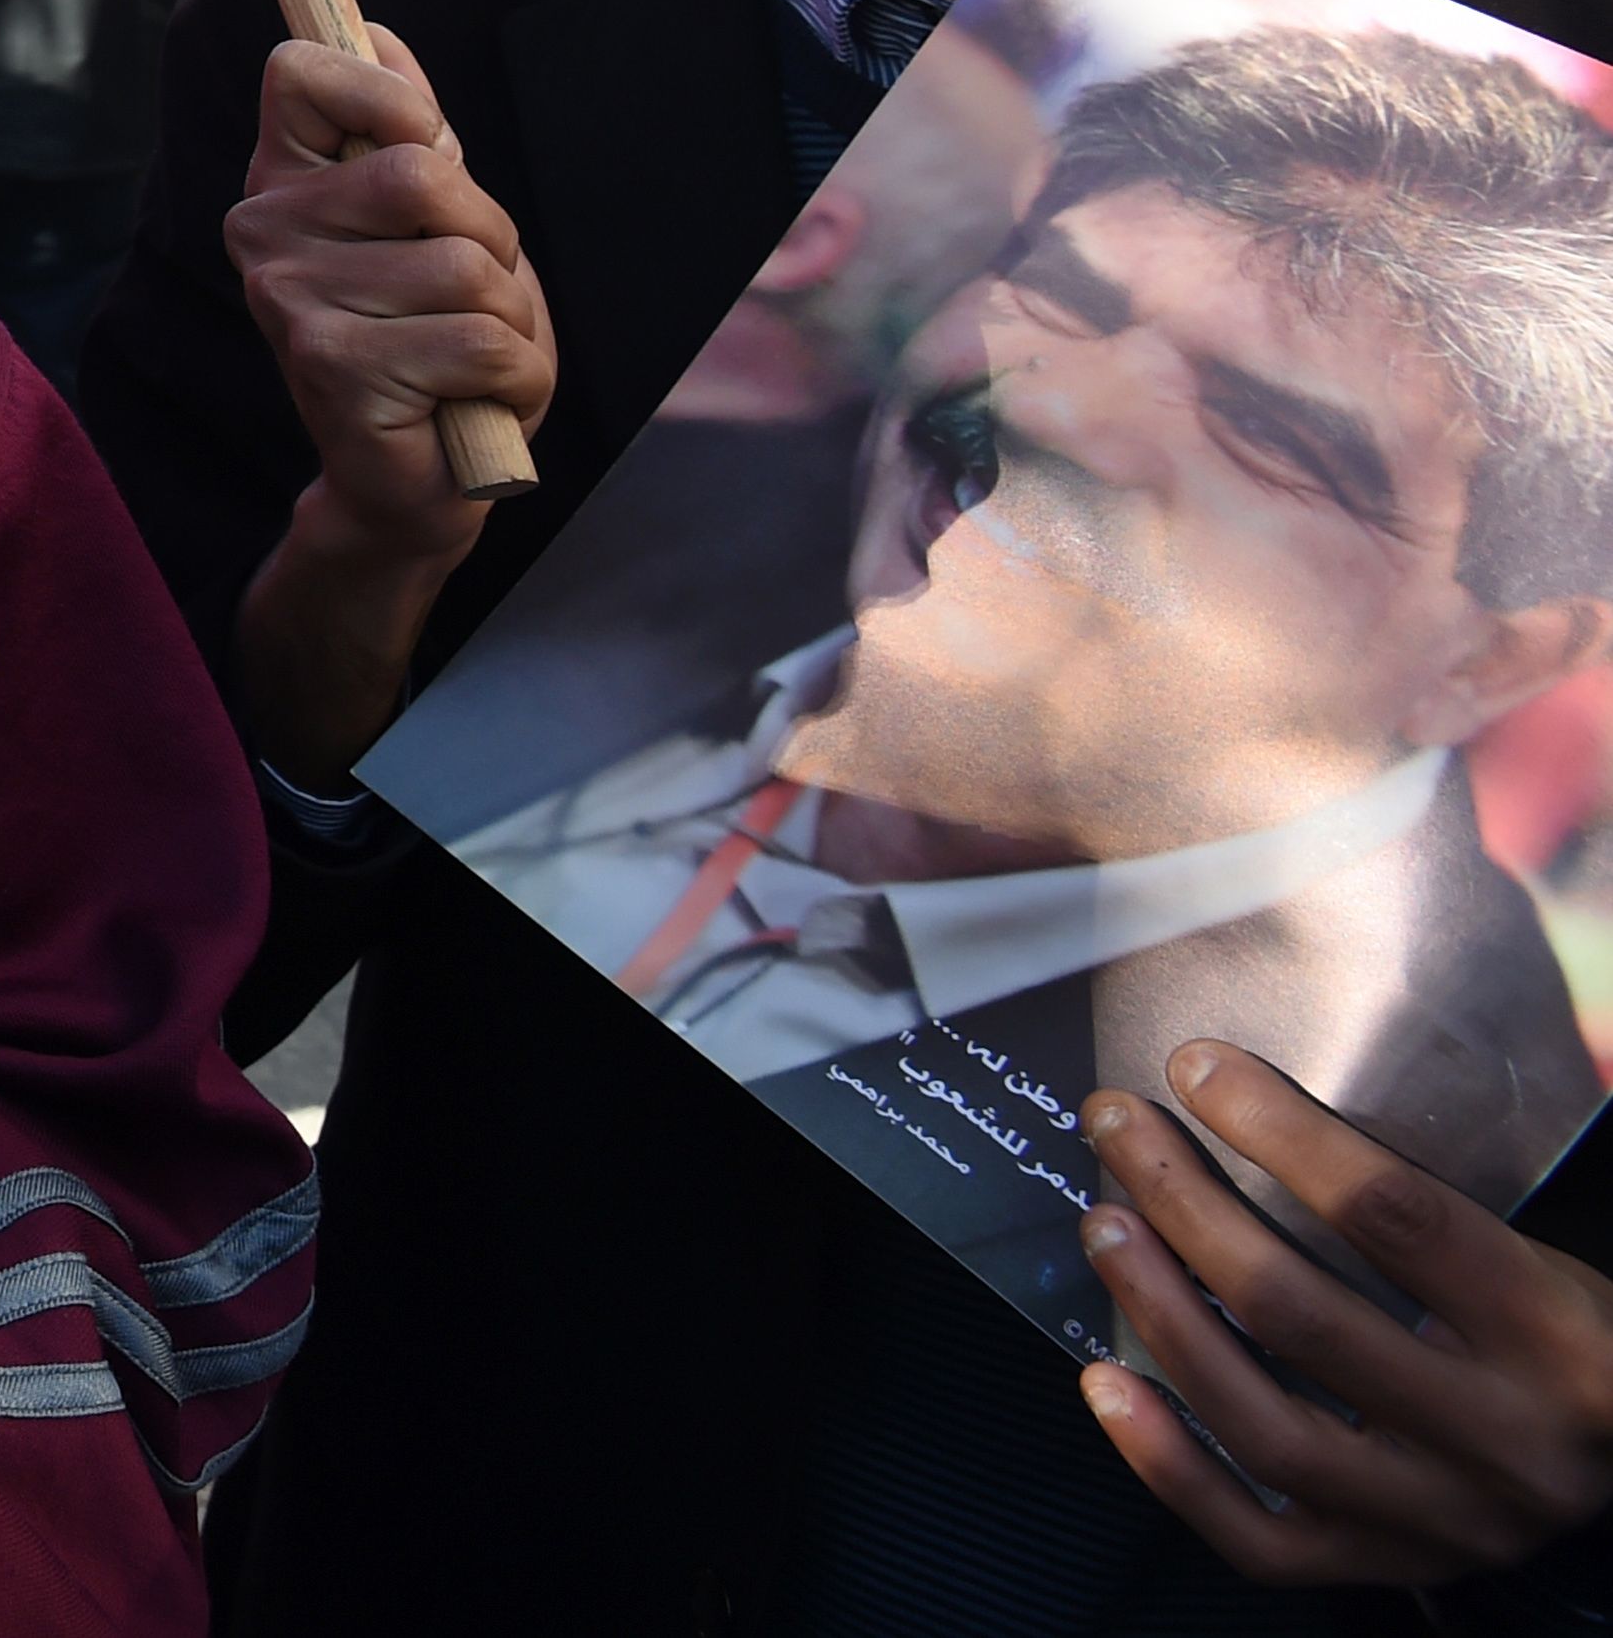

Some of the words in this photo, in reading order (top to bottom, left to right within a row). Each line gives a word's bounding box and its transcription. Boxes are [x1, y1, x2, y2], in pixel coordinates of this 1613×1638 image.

[825, 1062, 905, 1126] براهمي
[1004, 1070, 1077, 1131] وطن
[905, 1121, 971, 1175] محمد
[1017, 1161, 1092, 1212] دمر
